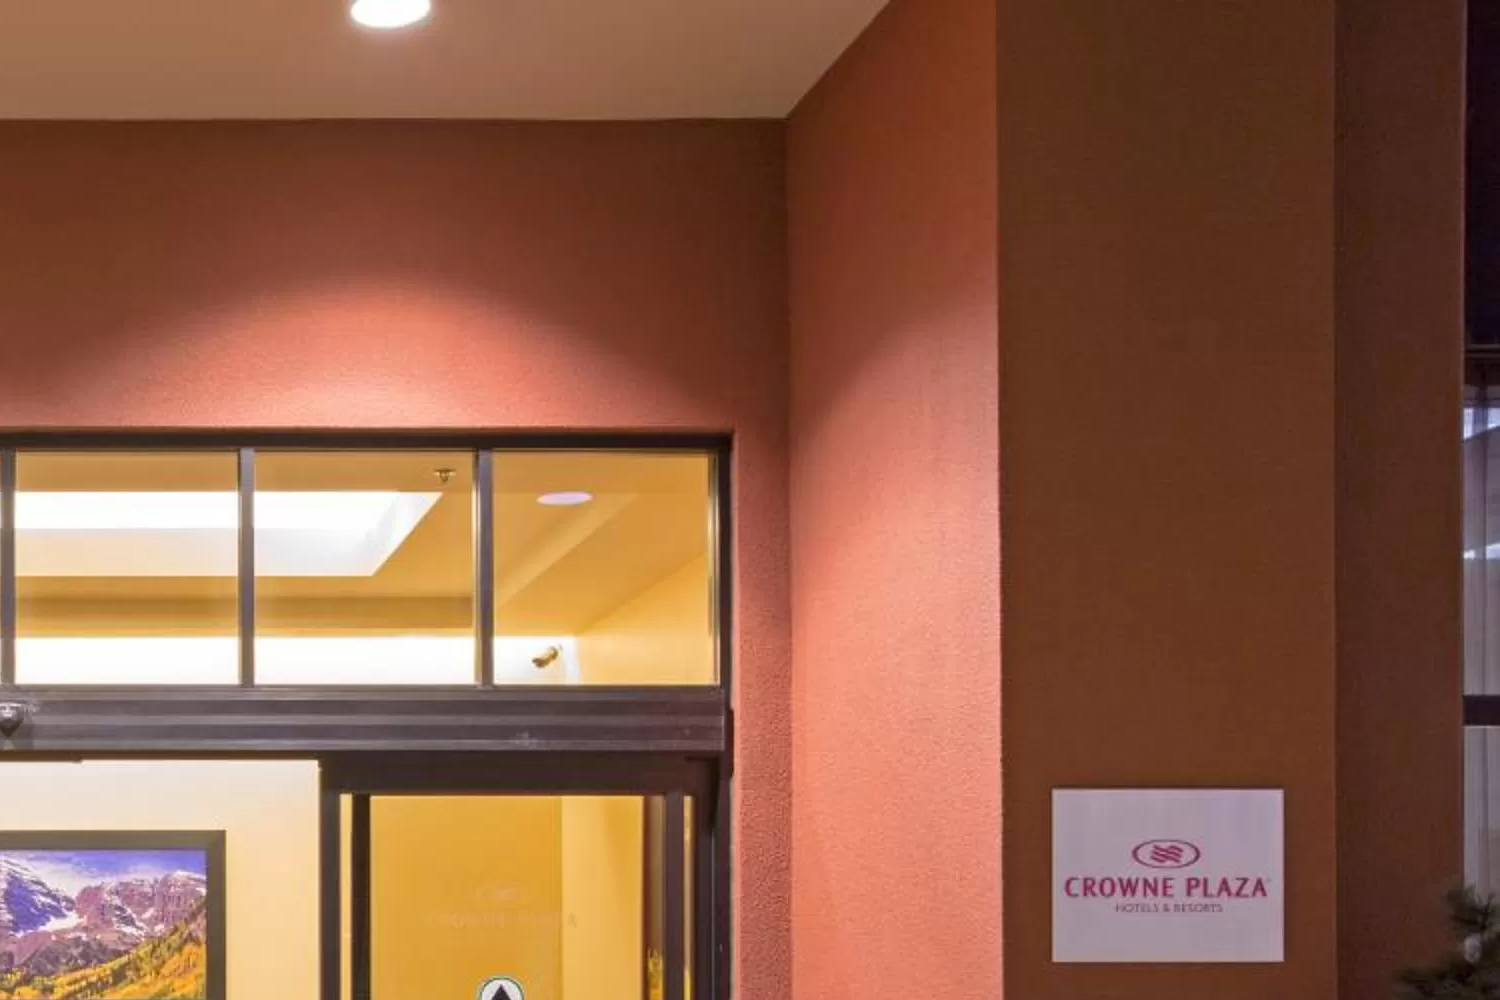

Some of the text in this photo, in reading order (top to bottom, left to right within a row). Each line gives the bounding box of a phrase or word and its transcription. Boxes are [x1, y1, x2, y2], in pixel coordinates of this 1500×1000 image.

[1064, 877, 1268, 898] CROWNE PLAZA
[1115, 903, 1223, 913] HOTELS & RESORTS
